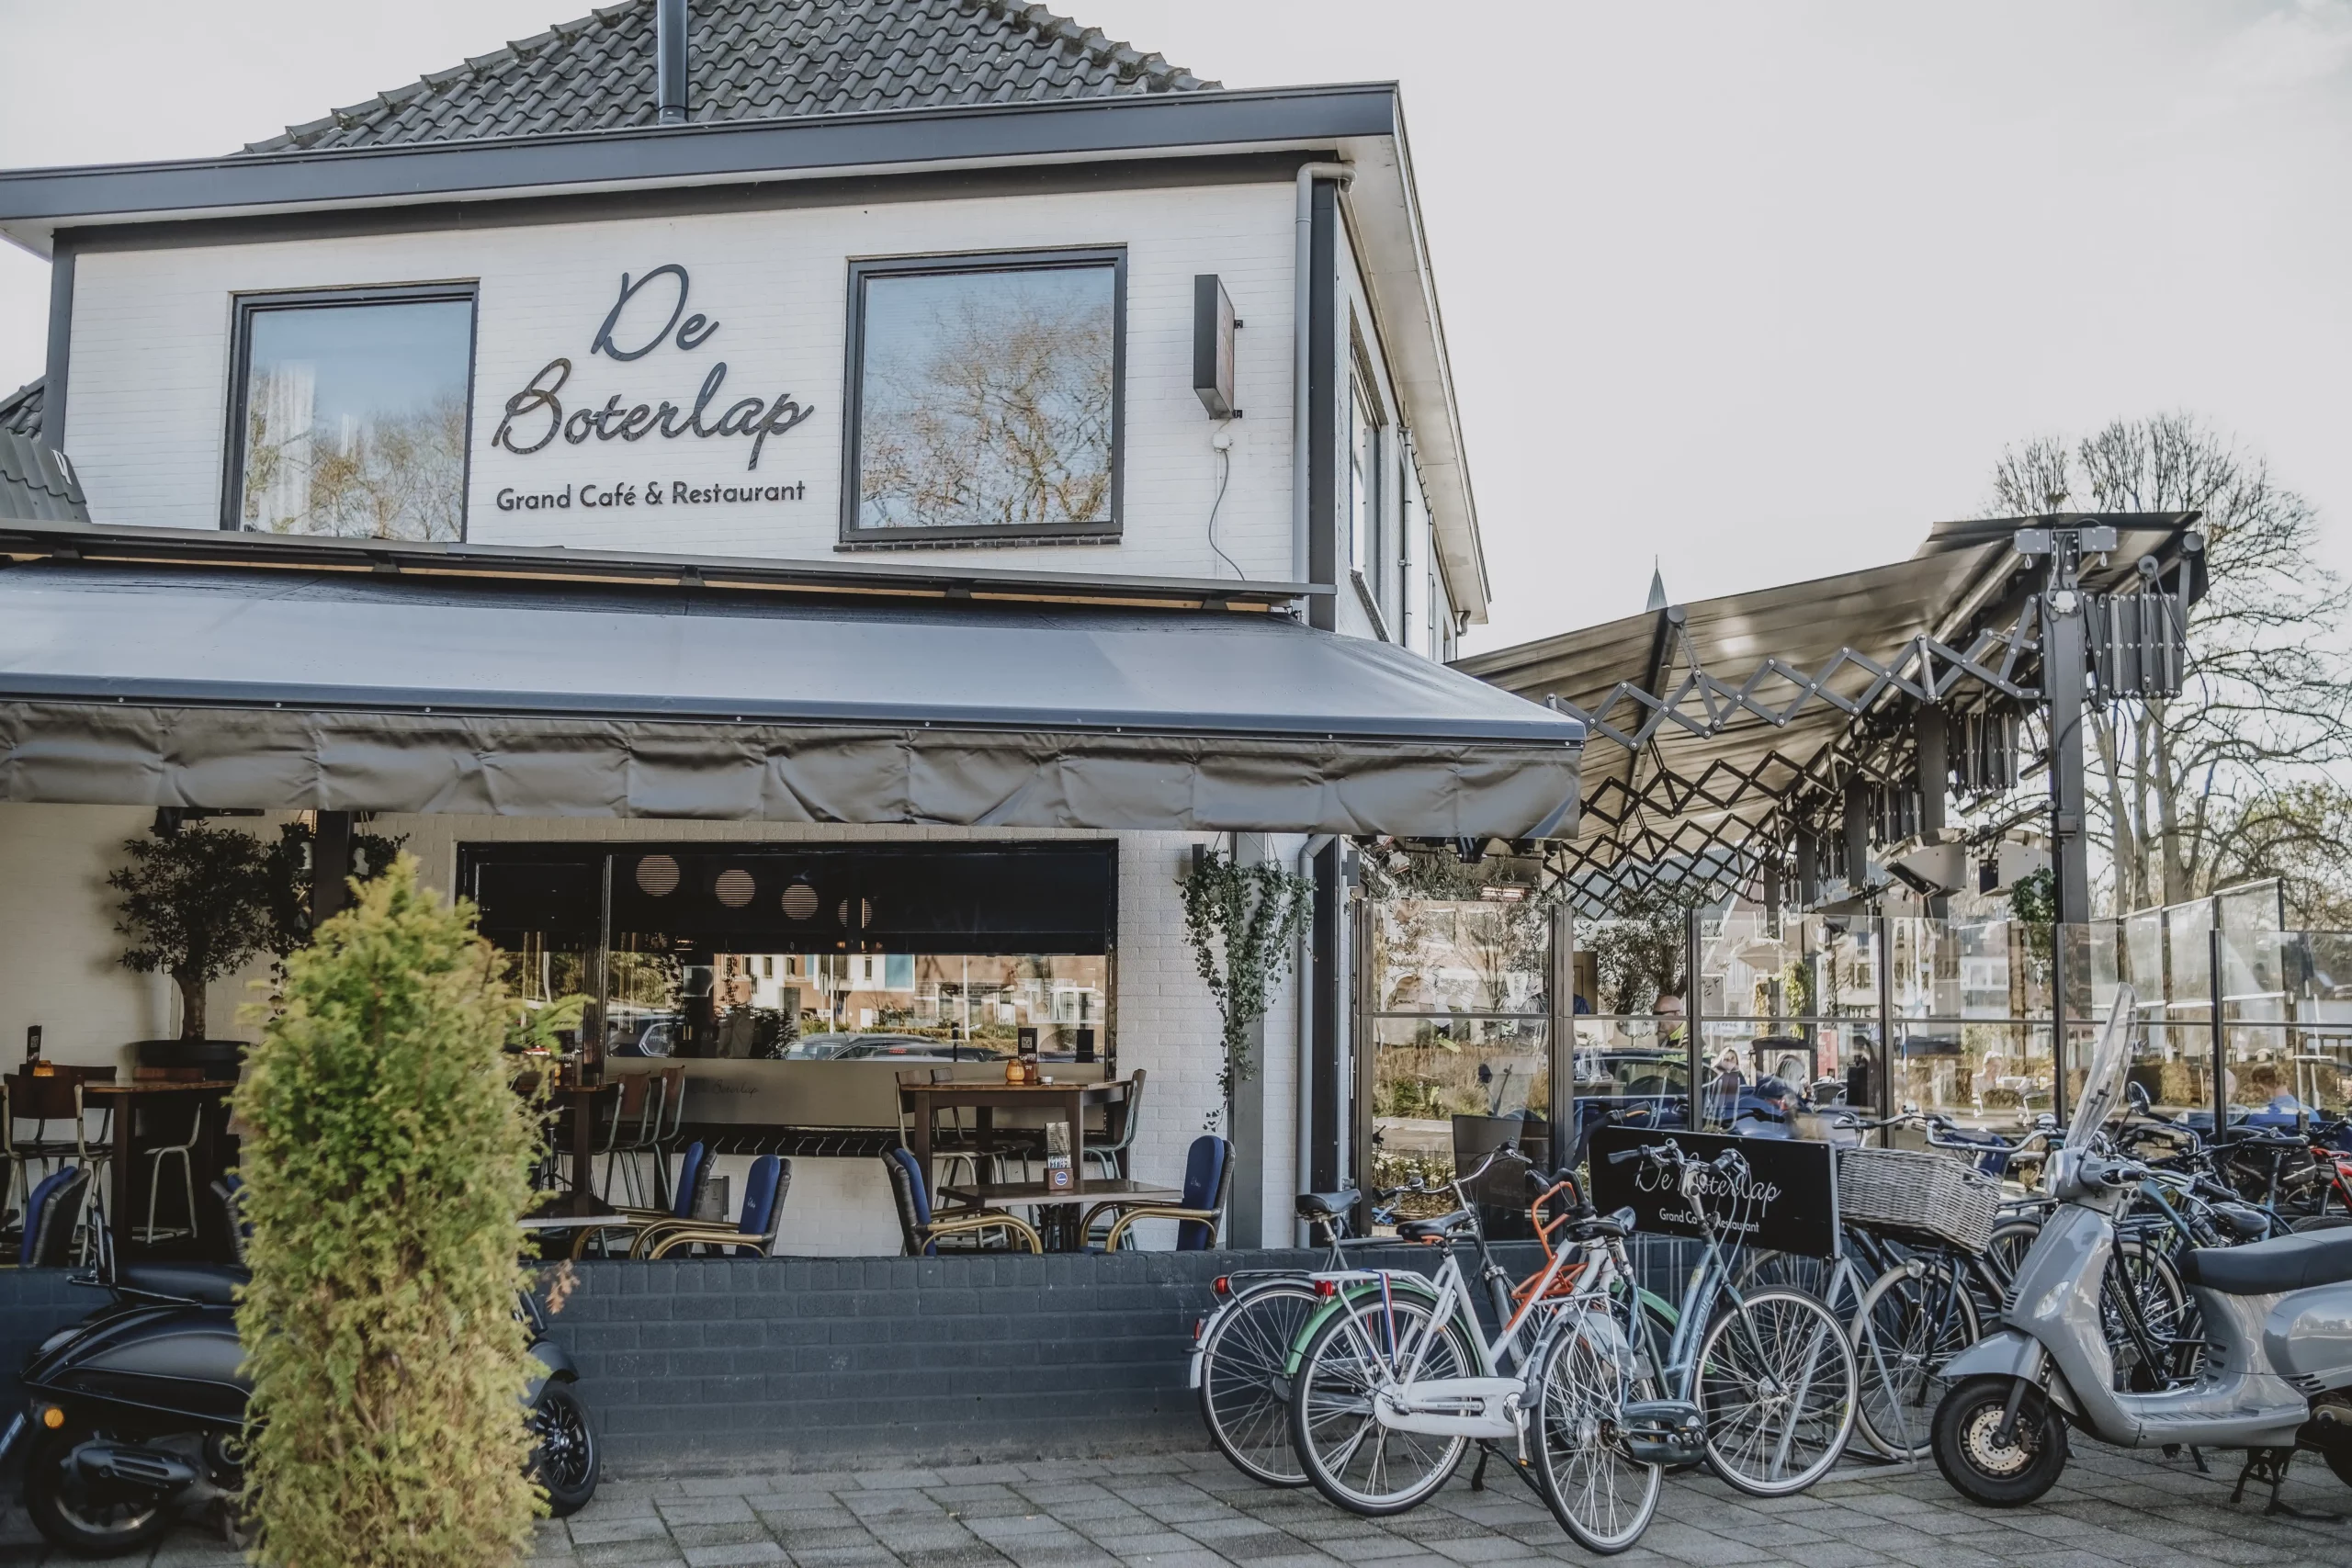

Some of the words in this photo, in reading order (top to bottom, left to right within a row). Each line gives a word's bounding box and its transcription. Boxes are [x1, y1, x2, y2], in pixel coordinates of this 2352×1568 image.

[591, 264, 719, 361] De
[492, 357, 815, 471] Boterlap
[496, 484, 571, 511] Grand
[580, 482, 636, 507] Café
[645, 481, 663, 505] &
[672, 480, 806, 504] Restaurant
[1659, 1208, 1684, 1224] Grand
[1715, 1215, 1759, 1233] estauant
